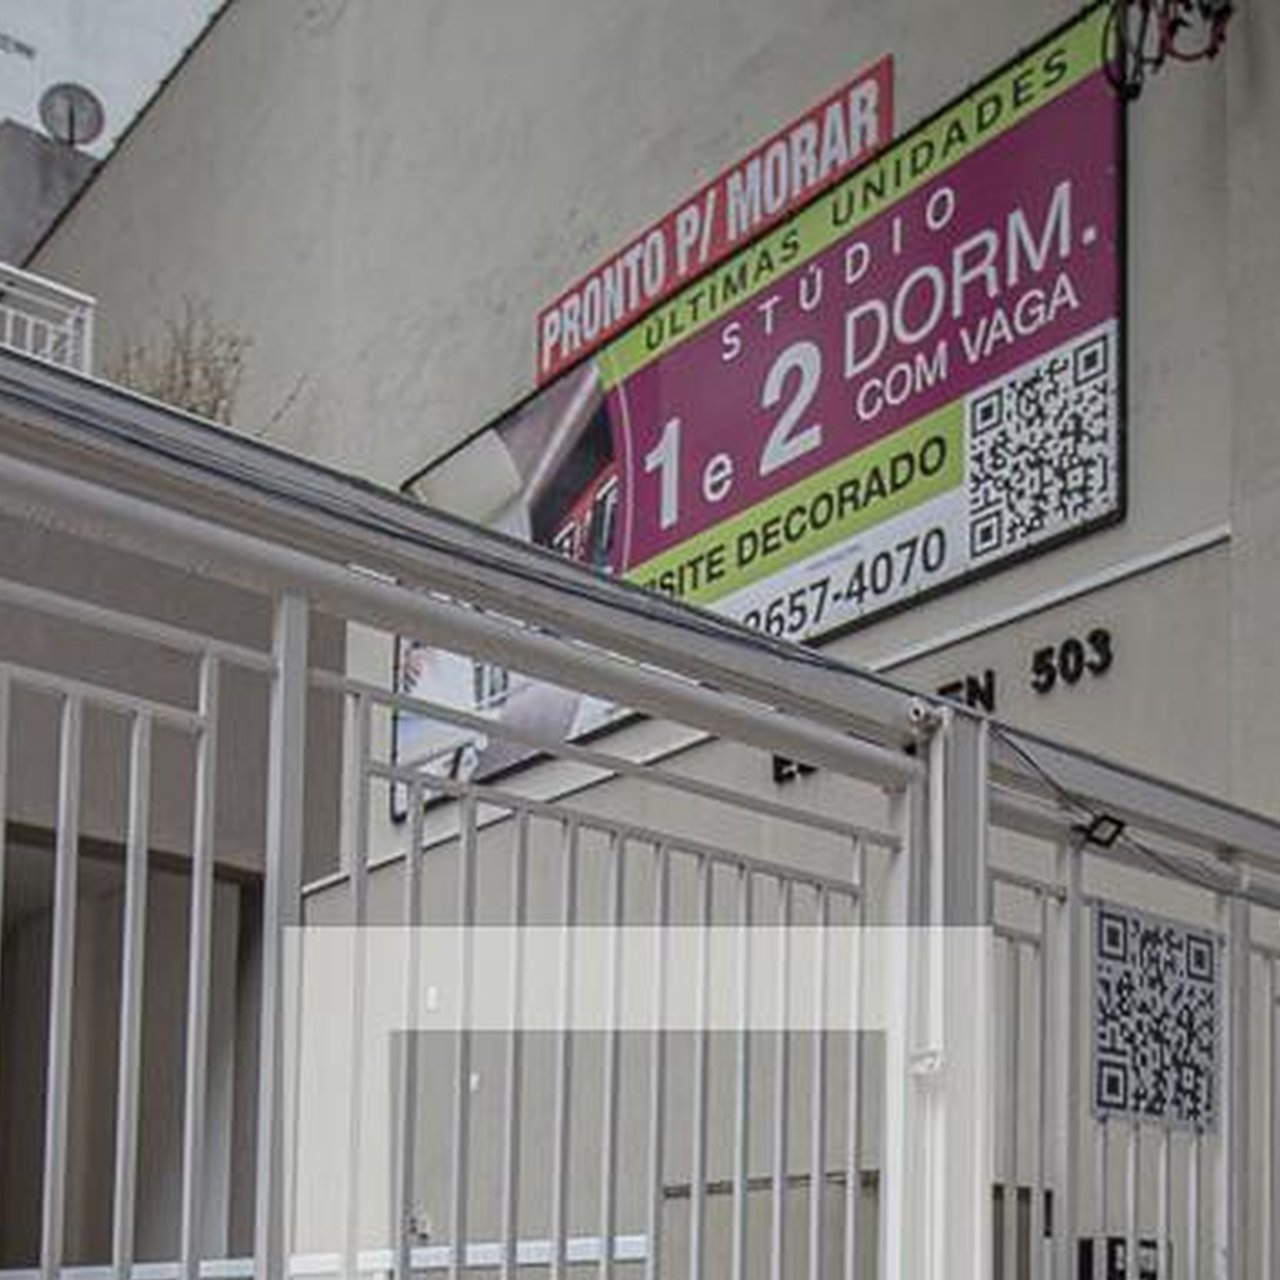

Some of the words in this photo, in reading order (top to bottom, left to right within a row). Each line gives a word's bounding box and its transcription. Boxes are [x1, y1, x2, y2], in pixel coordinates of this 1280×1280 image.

[831, 49, 1070, 228] UNIDADES
[542, 232, 666, 373] PRONTO
[676, 190, 716, 277] P/
[726, 78, 880, 242] MORAR
[644, 417, 680, 530] 1
[702, 452, 734, 502] e
[759, 341, 822, 478] 2
[845, 180, 1097, 380] DORM.
[856, 340, 948, 421] COM
[960, 272, 1080, 364] VAGA
[642, 544, 726, 597] SITE
[736, 434, 948, 569] DECORADO
[1030, 627, 1114, 695] 503
